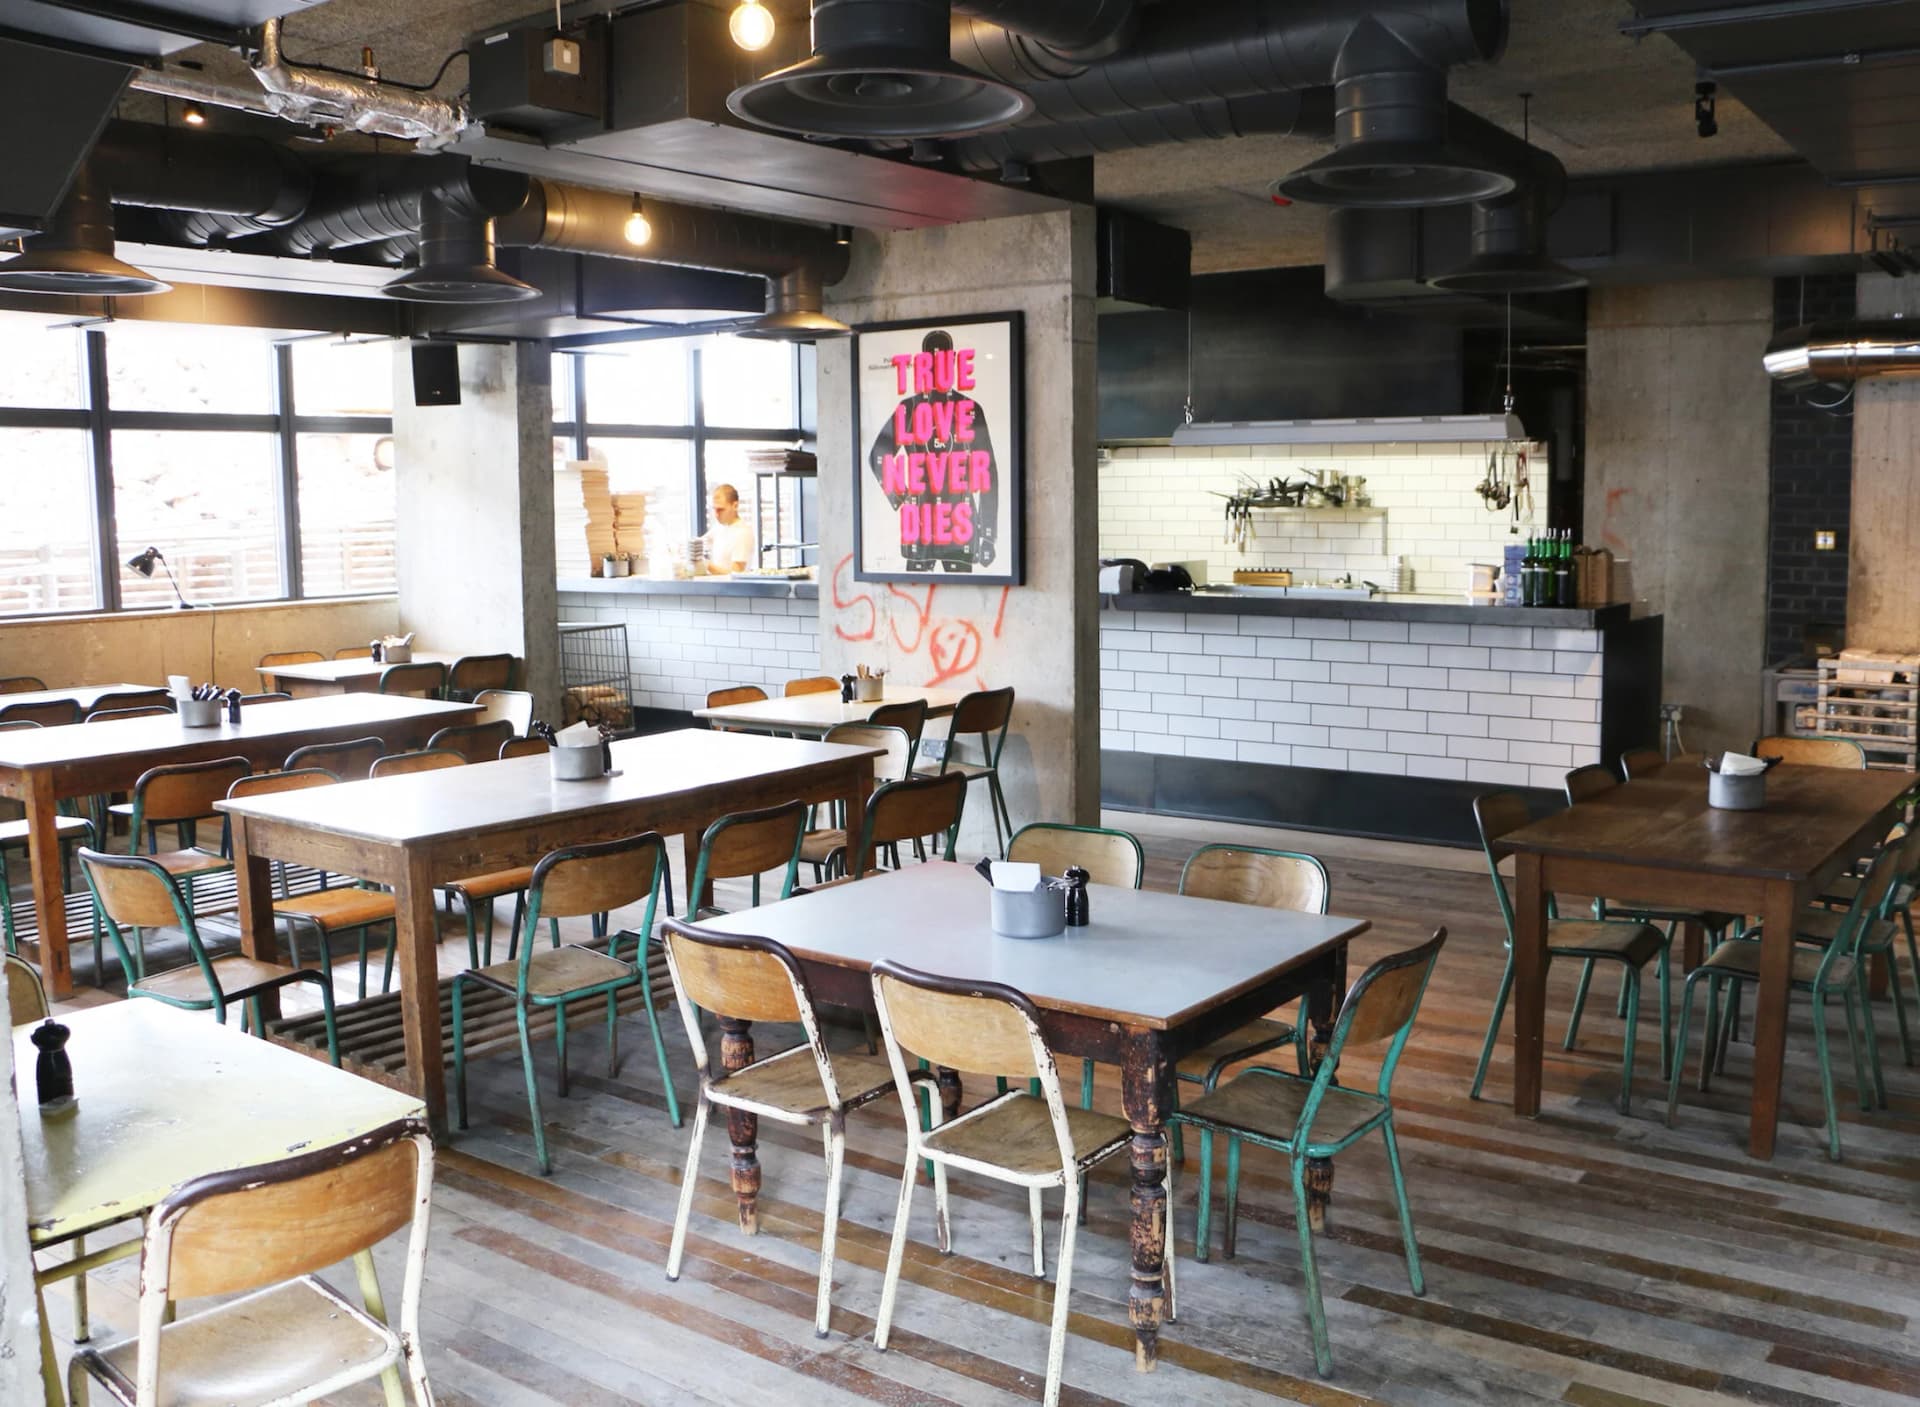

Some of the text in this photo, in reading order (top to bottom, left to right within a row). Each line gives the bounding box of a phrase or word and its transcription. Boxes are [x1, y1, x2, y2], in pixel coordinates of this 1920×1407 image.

[891, 348, 976, 395] TRUE
[894, 399, 976, 445] LOVE
[881, 449, 991, 495] NEVER
[900, 502, 974, 545] DIES
